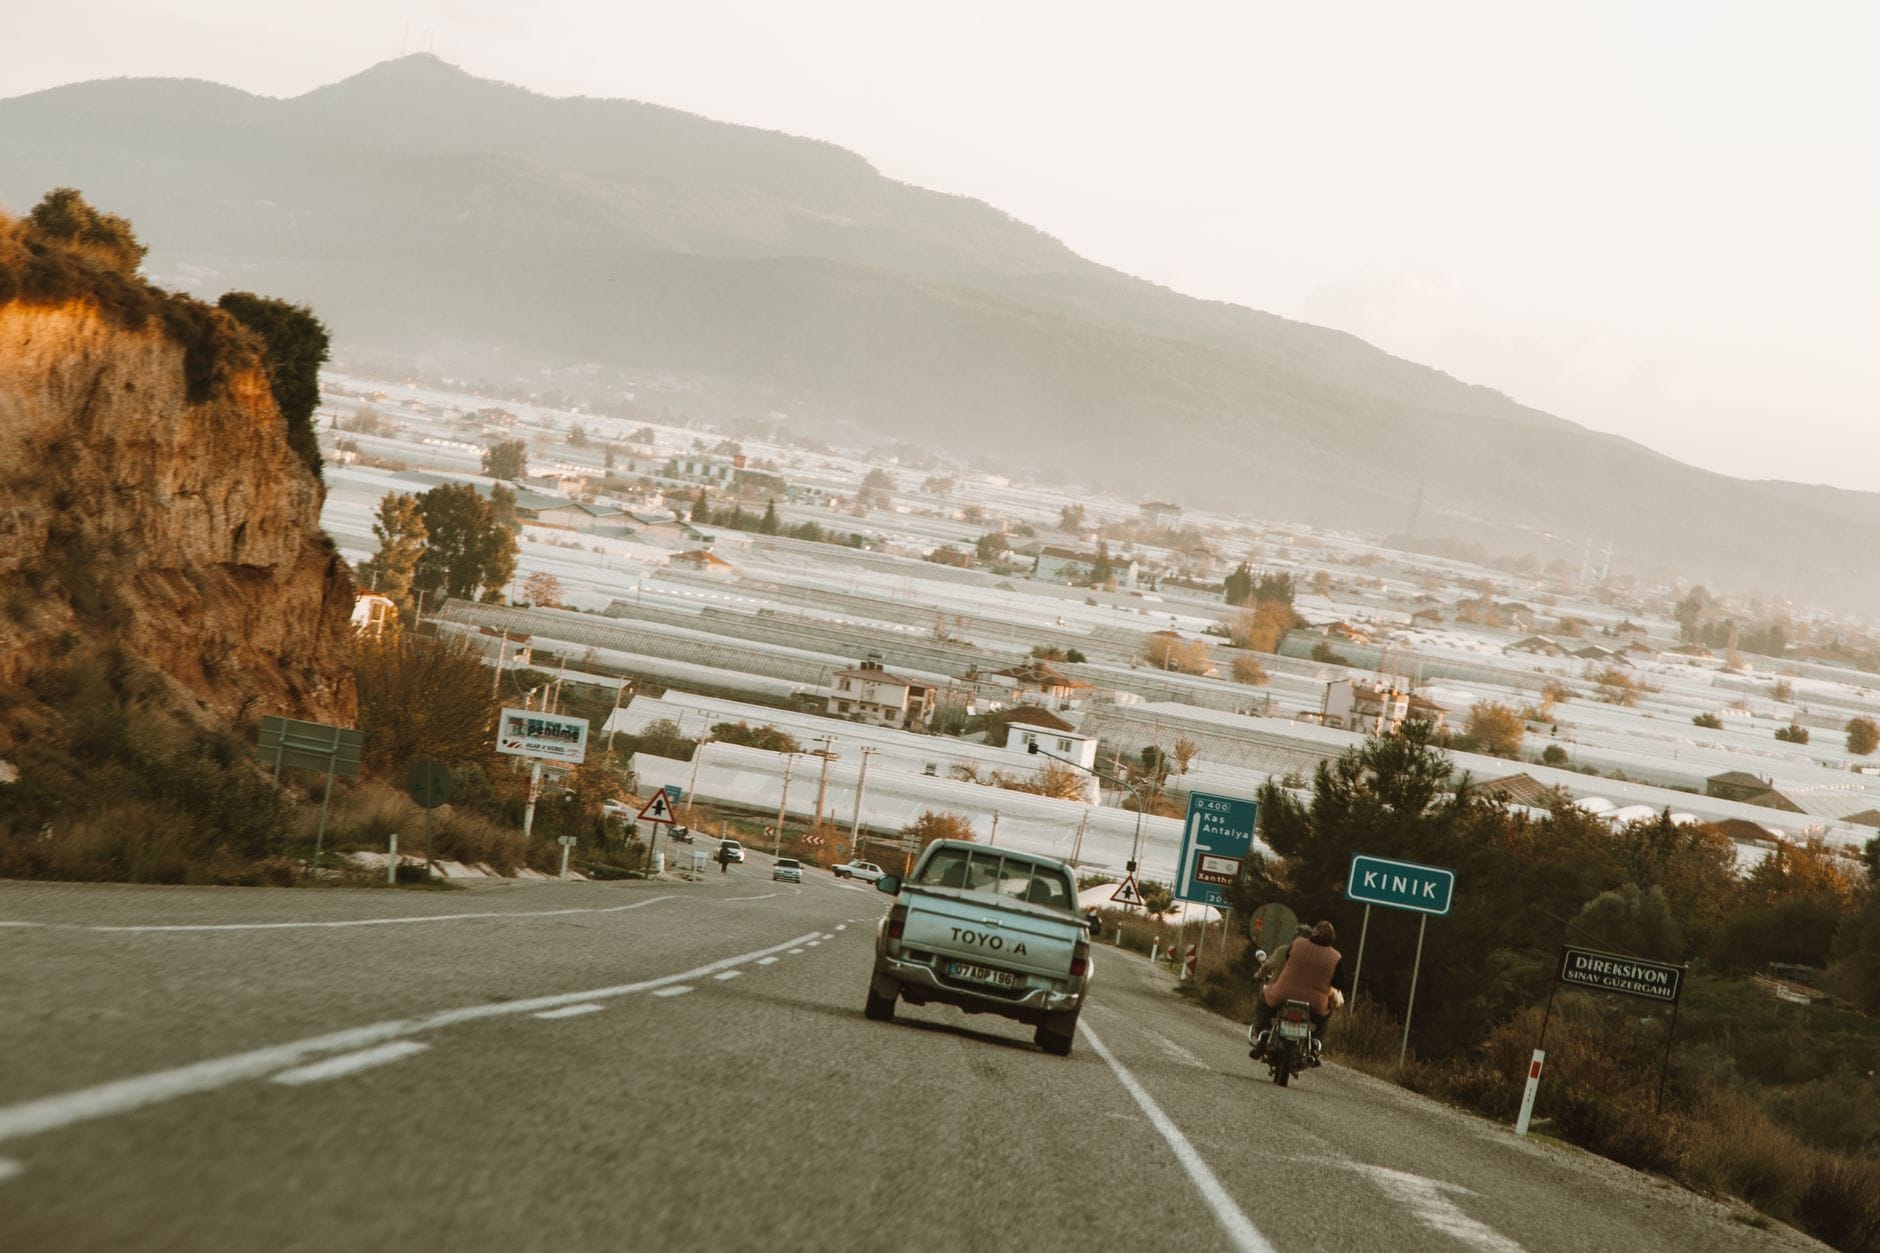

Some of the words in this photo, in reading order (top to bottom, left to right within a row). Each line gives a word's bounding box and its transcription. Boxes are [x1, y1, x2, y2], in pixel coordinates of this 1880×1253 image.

[1207, 802, 1228, 811] 400
[1202, 824, 1249, 840] Antalya
[1363, 870, 1438, 899] KINIK
[951, 927, 1026, 955] TOYOA
[1567, 970, 1601, 983] SINAV
[1575, 955, 1669, 985] DİREKSİYON
